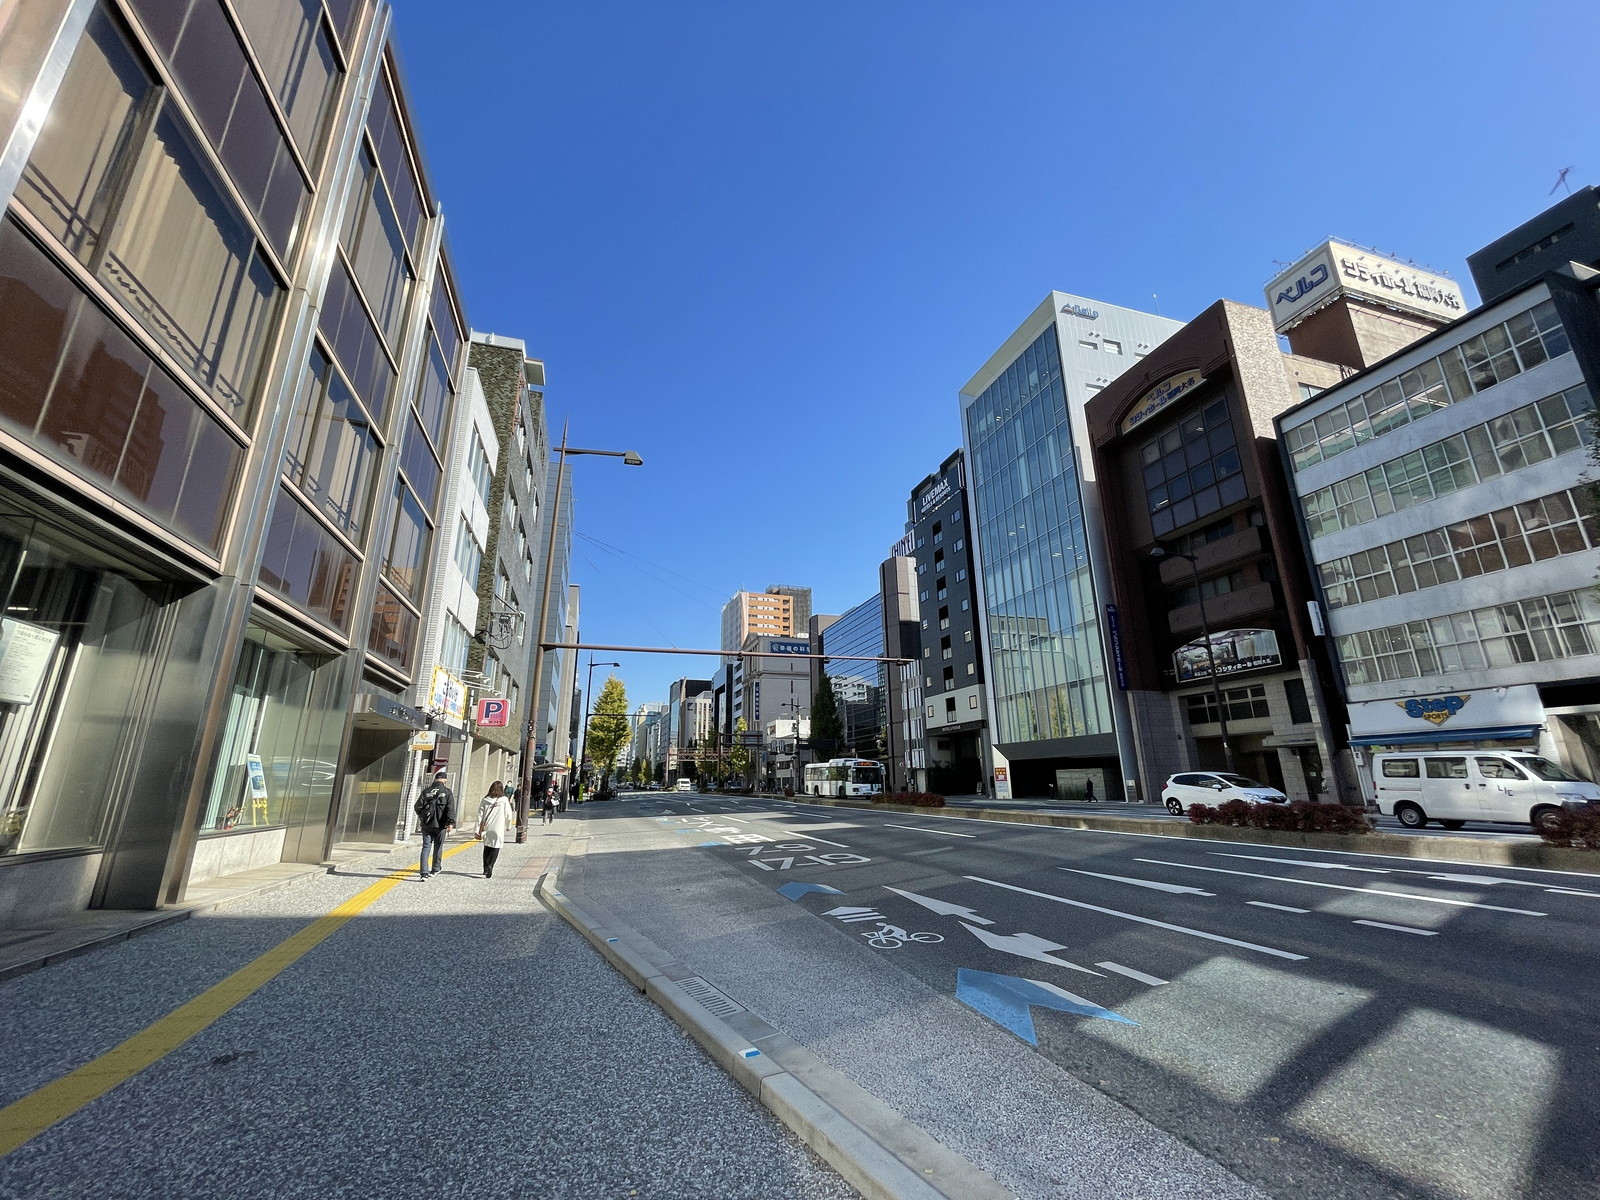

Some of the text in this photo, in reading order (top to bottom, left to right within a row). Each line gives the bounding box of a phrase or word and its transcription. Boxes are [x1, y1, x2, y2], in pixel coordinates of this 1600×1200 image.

[1275, 263, 1329, 305] ベルコ
[1146, 382, 1171, 401] ベルコ
[922, 477, 949, 506] LIVEMAX
[484, 700, 503, 719] P
[1404, 695, 1465, 718] Step
[1423, 712, 1449, 720] SPORTS
[747, 853, 871, 871] 17-19
